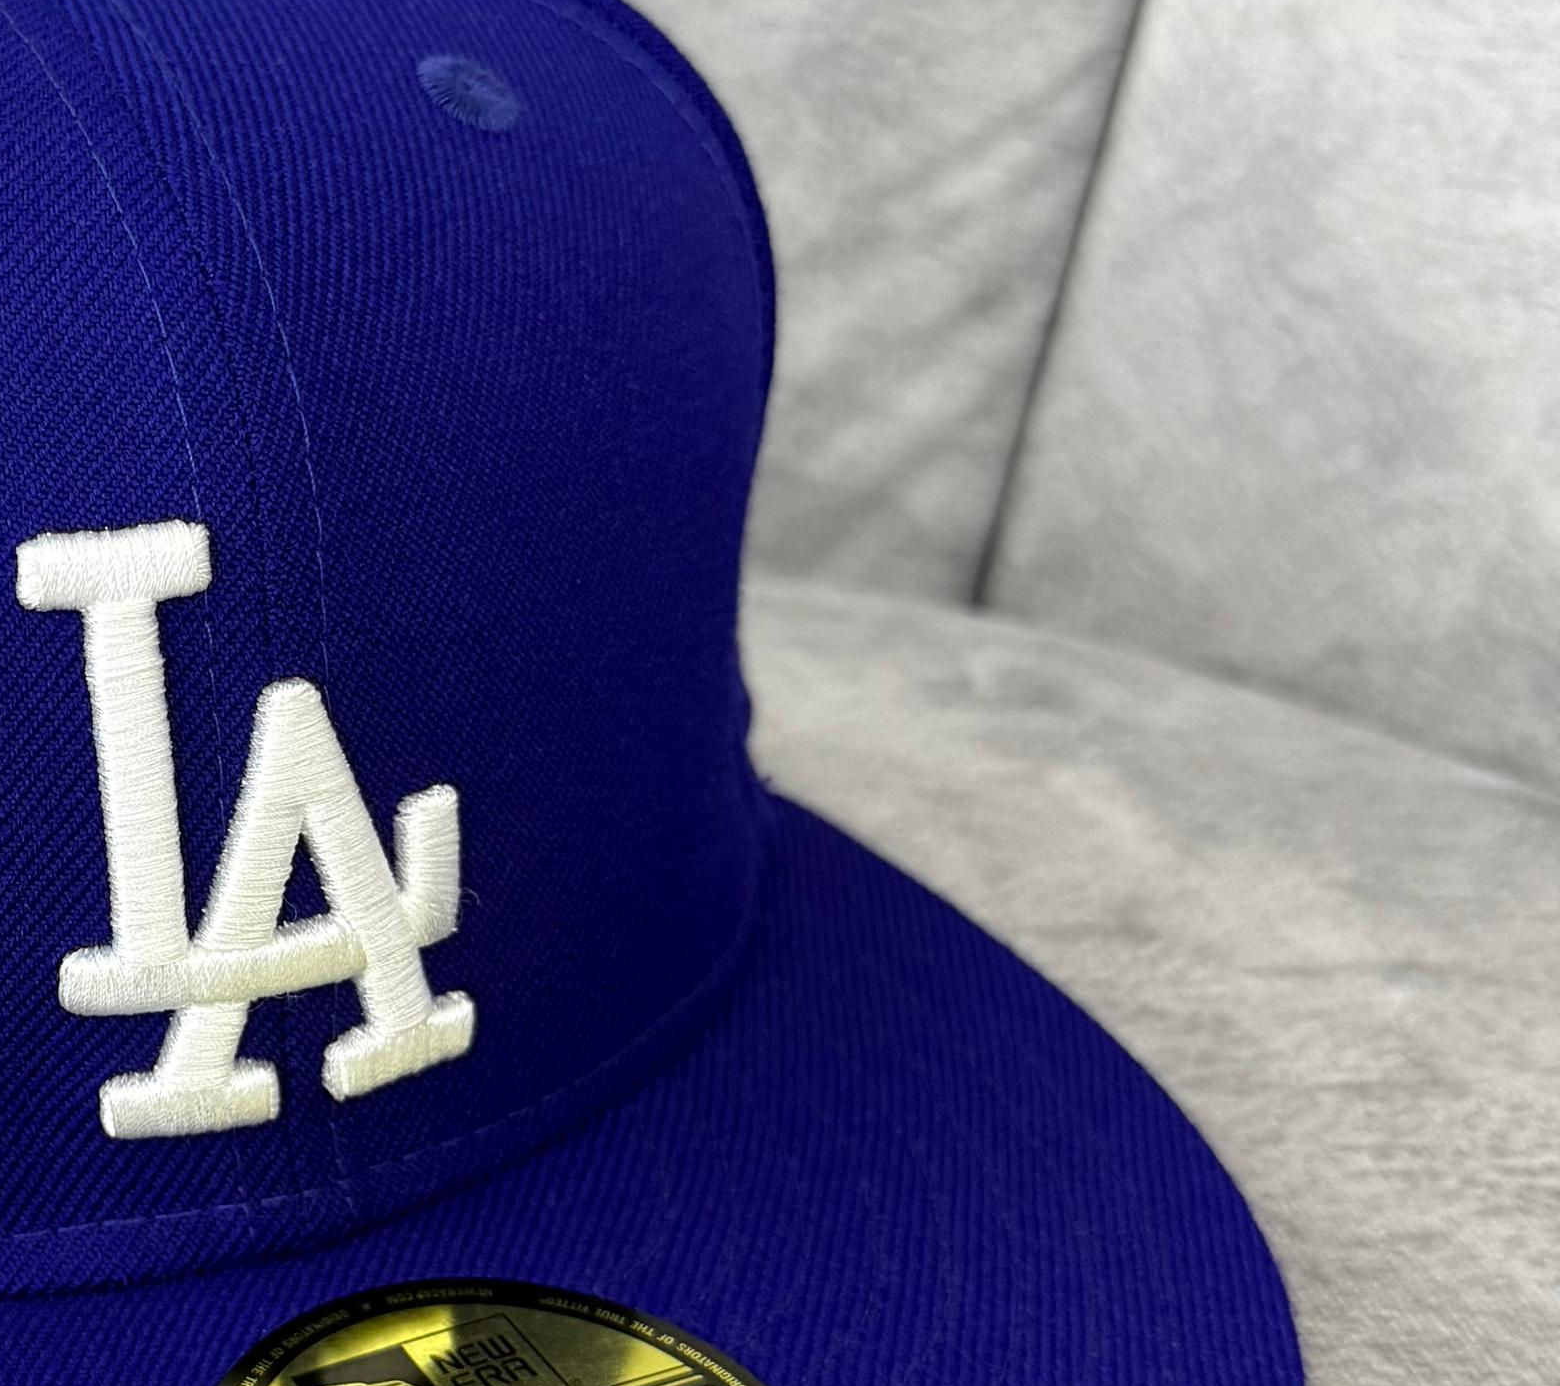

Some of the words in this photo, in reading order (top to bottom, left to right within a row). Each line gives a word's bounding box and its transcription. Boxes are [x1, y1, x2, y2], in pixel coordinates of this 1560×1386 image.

[16, 519, 474, 1139] LA
[630, 1320, 655, 1336] THE
[656, 1333, 675, 1346] OF
[430, 1335, 517, 1374] NEW
[251, 1358, 274, 1377] THE
